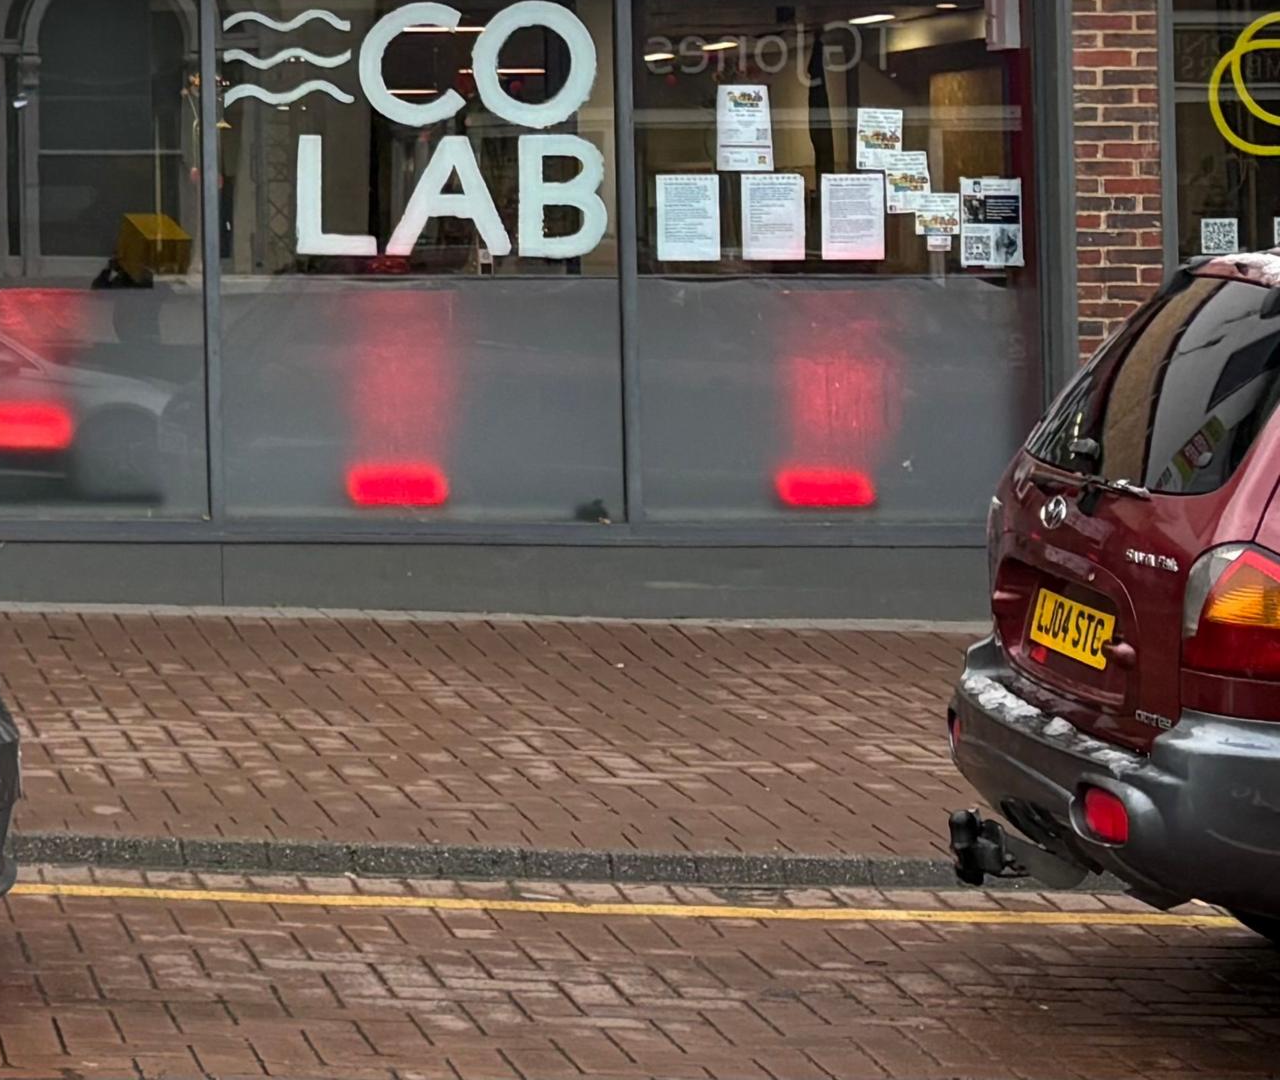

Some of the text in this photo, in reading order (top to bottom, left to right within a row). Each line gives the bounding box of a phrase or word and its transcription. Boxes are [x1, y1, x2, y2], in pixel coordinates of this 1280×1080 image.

[359, 0, 598, 129] CO
[296, 134, 609, 260] LAB
[1037, 594, 1073, 644] LJ04
